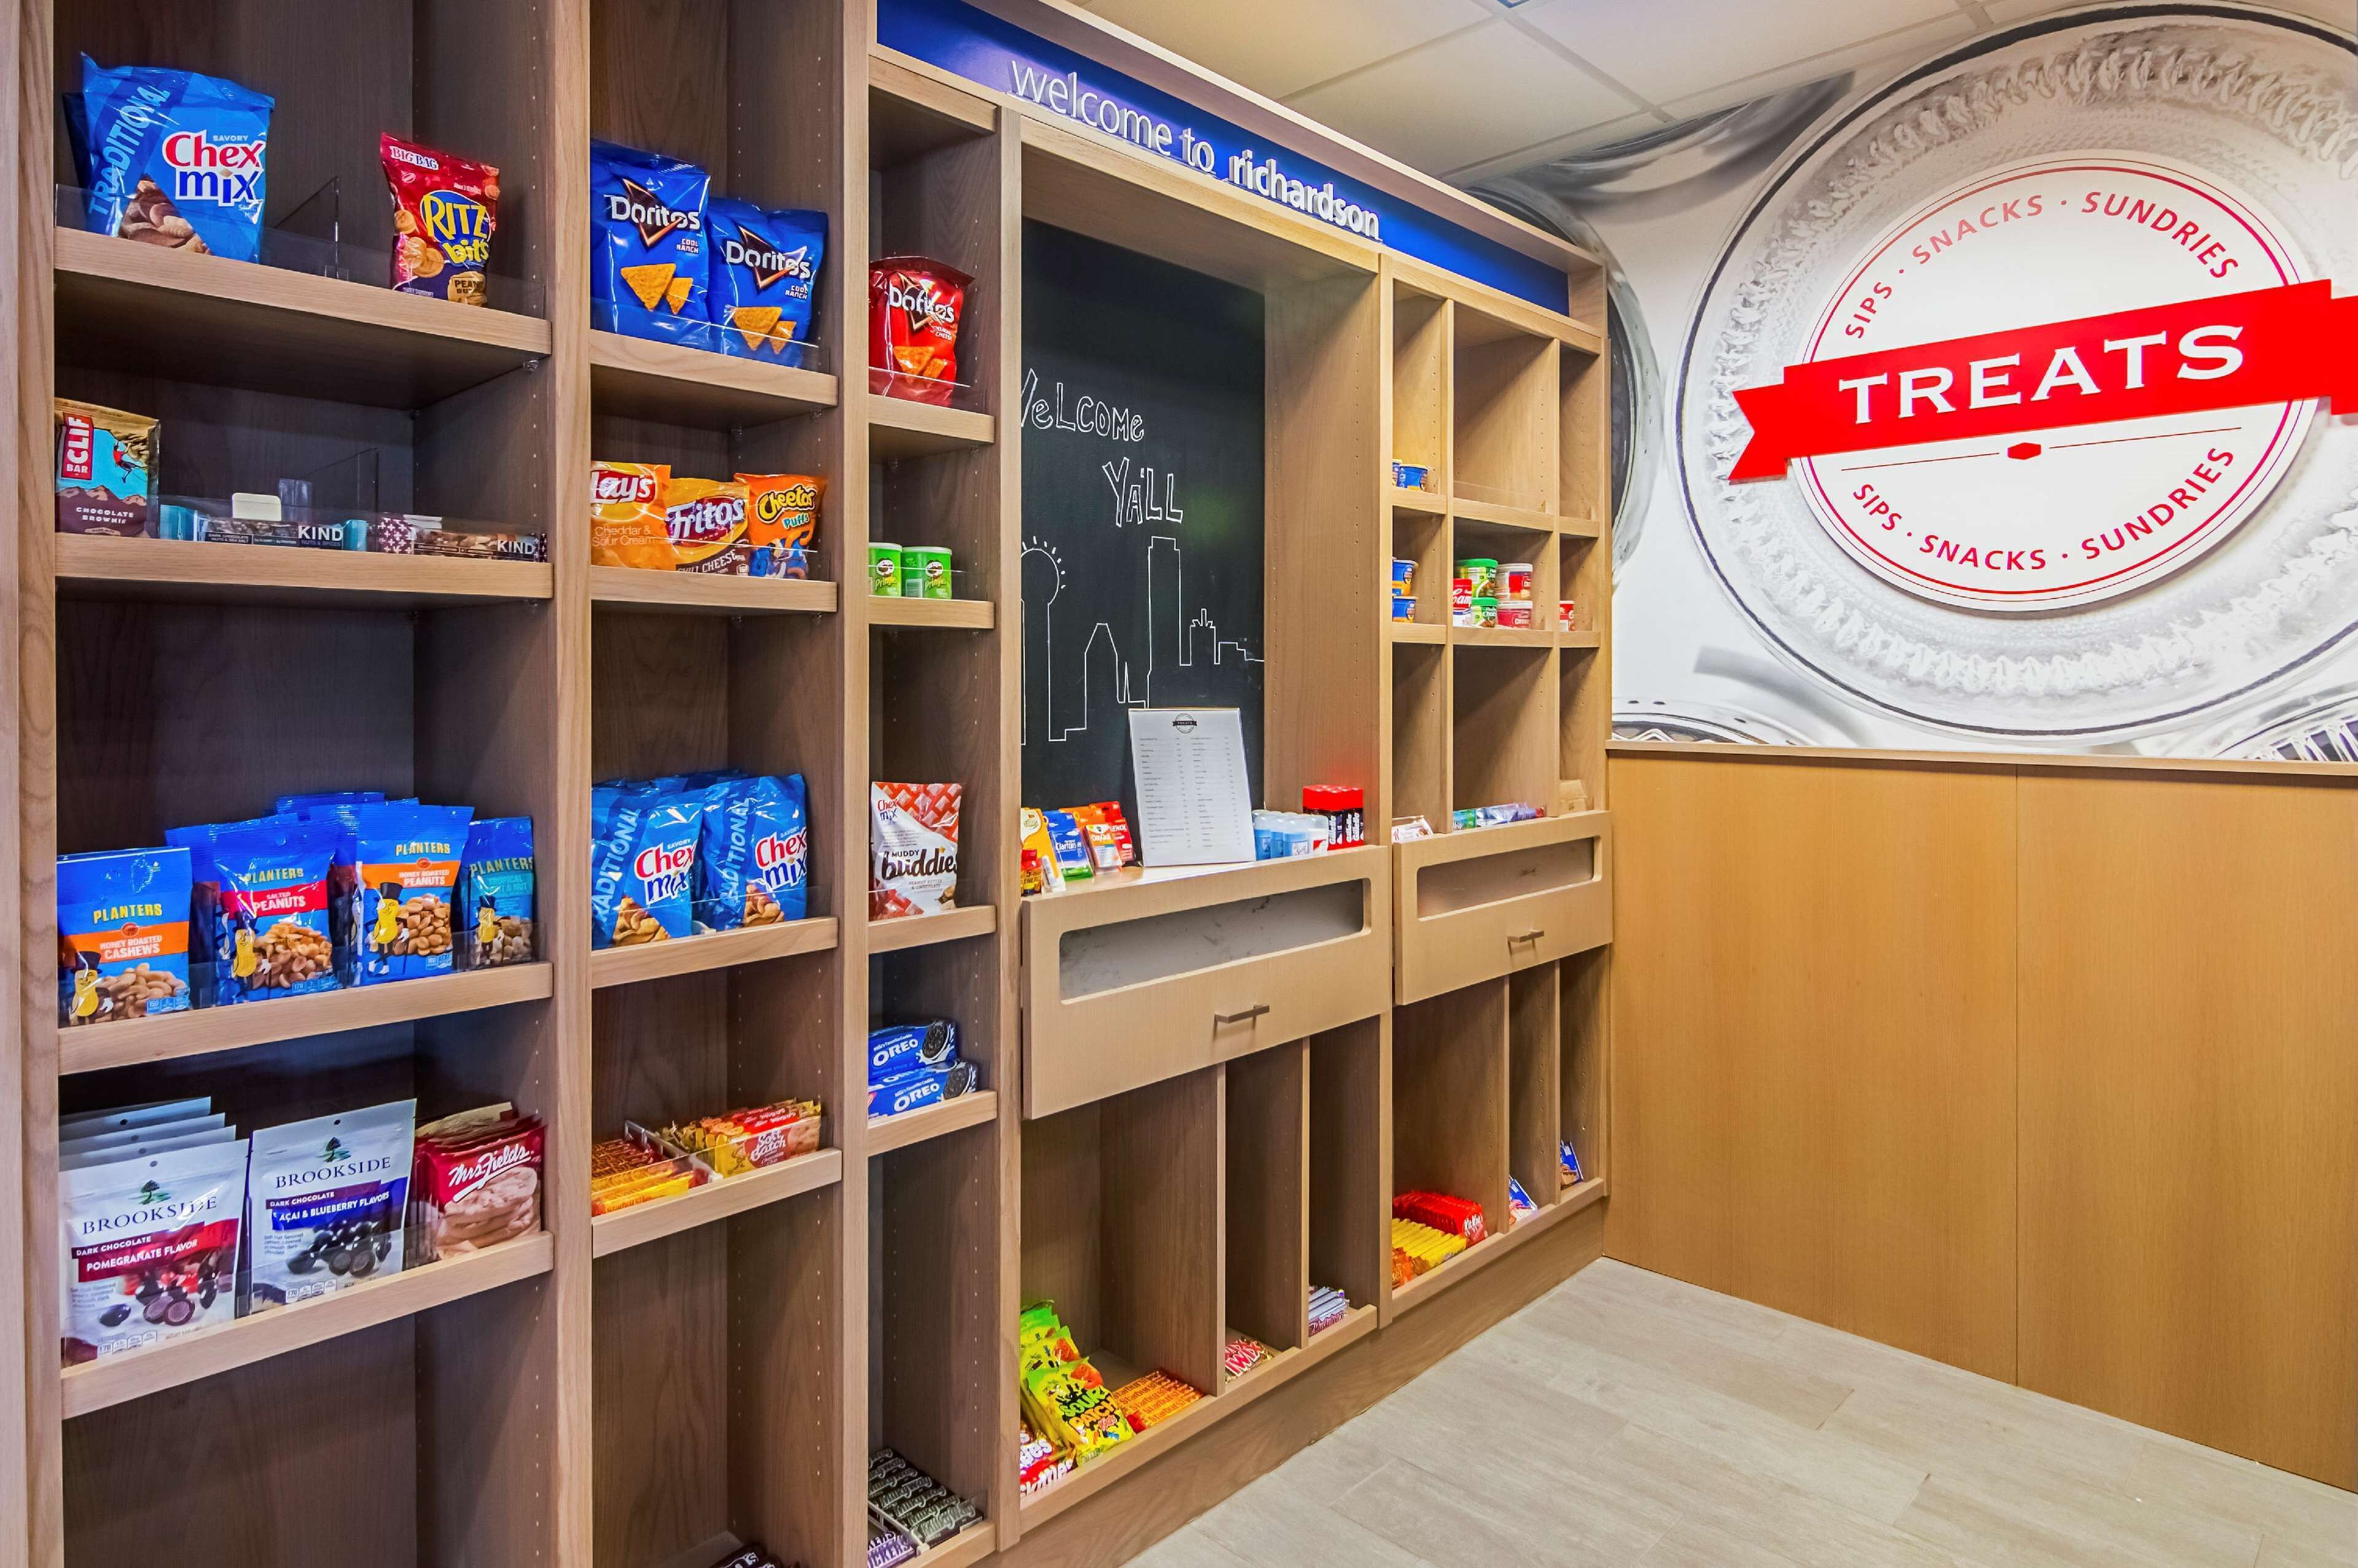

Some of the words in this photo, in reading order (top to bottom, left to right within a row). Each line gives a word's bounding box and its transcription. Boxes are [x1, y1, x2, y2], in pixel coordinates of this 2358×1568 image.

[164, 133, 265, 169] Chex
[390, 146, 414, 162] BIG
[415, 155, 439, 170] BAG
[1011, 60, 1173, 156] welcome
[1179, 128, 1215, 173] to
[1229, 149, 1382, 240] richardson
[178, 169, 260, 204] mix
[423, 194, 488, 240] RITZ
[610, 195, 701, 230] Doritos
[442, 238, 490, 264] bits
[676, 244, 699, 254] RANCH
[725, 240, 811, 279] Doritos
[1845, 281, 1893, 340] SIPS
[1911, 193, 2044, 265] SNACKS
[2081, 191, 2239, 279] SUNDRIES
[785, 290, 808, 300] RANCH
[791, 284, 808, 294] COOL
[1840, 325, 2245, 425] TREATS
[67, 416, 90, 464] CLIF
[66, 464, 88, 474] BAR
[76, 507, 134, 518] CHOCOLATE
[758, 483, 816, 520] Cheetos
[1853, 483, 1902, 532] SIPS
[1919, 534, 2047, 572] SNACKS
[2080, 446, 2235, 561] SUNDRIES
[82, 515, 127, 524] BROWNIE
[594, 526, 641, 537] Cheddar
[643, 525, 650, 535] &
[666, 499, 746, 540] Fritos
[299, 525, 343, 541] KIND
[592, 536, 618, 547] Sour
[497, 540, 536, 555] KIND
[701, 548, 738, 573] CHEESE
[877, 799, 897, 811] Chex
[880, 808, 897, 821] mix
[396, 842, 451, 856] PLANTERS
[756, 827, 806, 867] Chex
[636, 842, 697, 879] Chex
[764, 852, 806, 889] mix
[245, 868, 304, 884] PLANTERS
[399, 870, 421, 878] HONEY
[404, 876, 446, 886] PEANUTS
[647, 872, 689, 902] mix
[93, 903, 163, 924] PLANTERS
[254, 895, 306, 912] PEANUTS
[100, 938, 127, 950] HONEY
[128, 934, 163, 946] ROASTED
[104, 943, 161, 961] CASHEWS
[873, 1039, 919, 1067] OREO
[894, 1082, 940, 1112] OREO
[751, 1135, 787, 1161] Batch
[757, 1128, 782, 1147] Soft
[275, 1156, 391, 1188] BROOKSIDE
[477, 1144, 529, 1190] Fields
[270, 1198, 290, 1207] DARK
[291, 1192, 335, 1205] CHOCOLATE
[279, 1211, 300, 1223] AÇAI
[310, 1199, 358, 1217] BLUEBERRY
[359, 1192, 389, 1207] FLAVORS
[76, 1246, 99, 1257] DARK
[101, 1236, 152, 1252] CHOCOLATE
[87, 1249, 162, 1271] POMEGRANATE
[164, 1239, 198, 1255] FLAVOR
[1060, 1386, 1106, 1417] SOUR
[1069, 1395, 1118, 1428] PATCH
